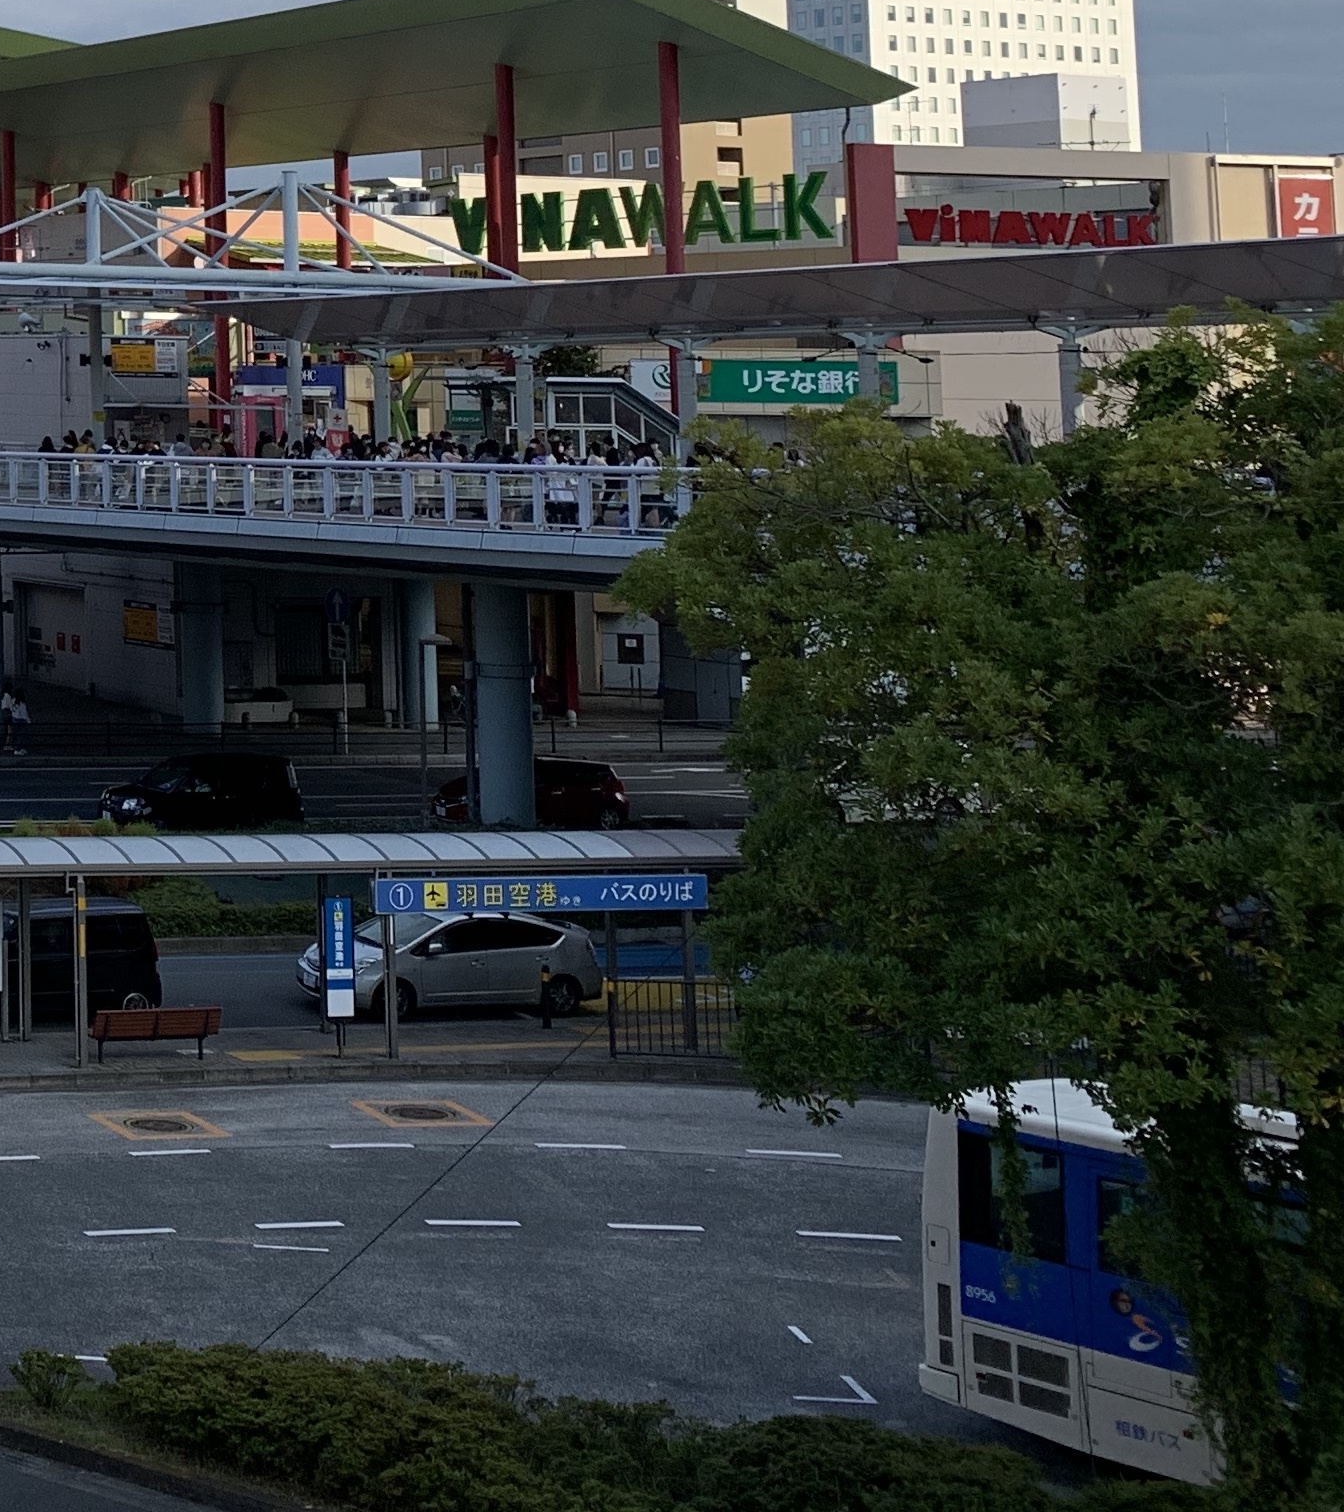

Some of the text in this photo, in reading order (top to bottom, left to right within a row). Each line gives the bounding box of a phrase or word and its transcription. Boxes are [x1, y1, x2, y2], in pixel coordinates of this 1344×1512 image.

[456, 882, 558, 908] 羽田空港
[559, 895, 582, 907] ゆき
[600, 881, 694, 902] バスのりば
[965, 1284, 997, 1304] 8956
